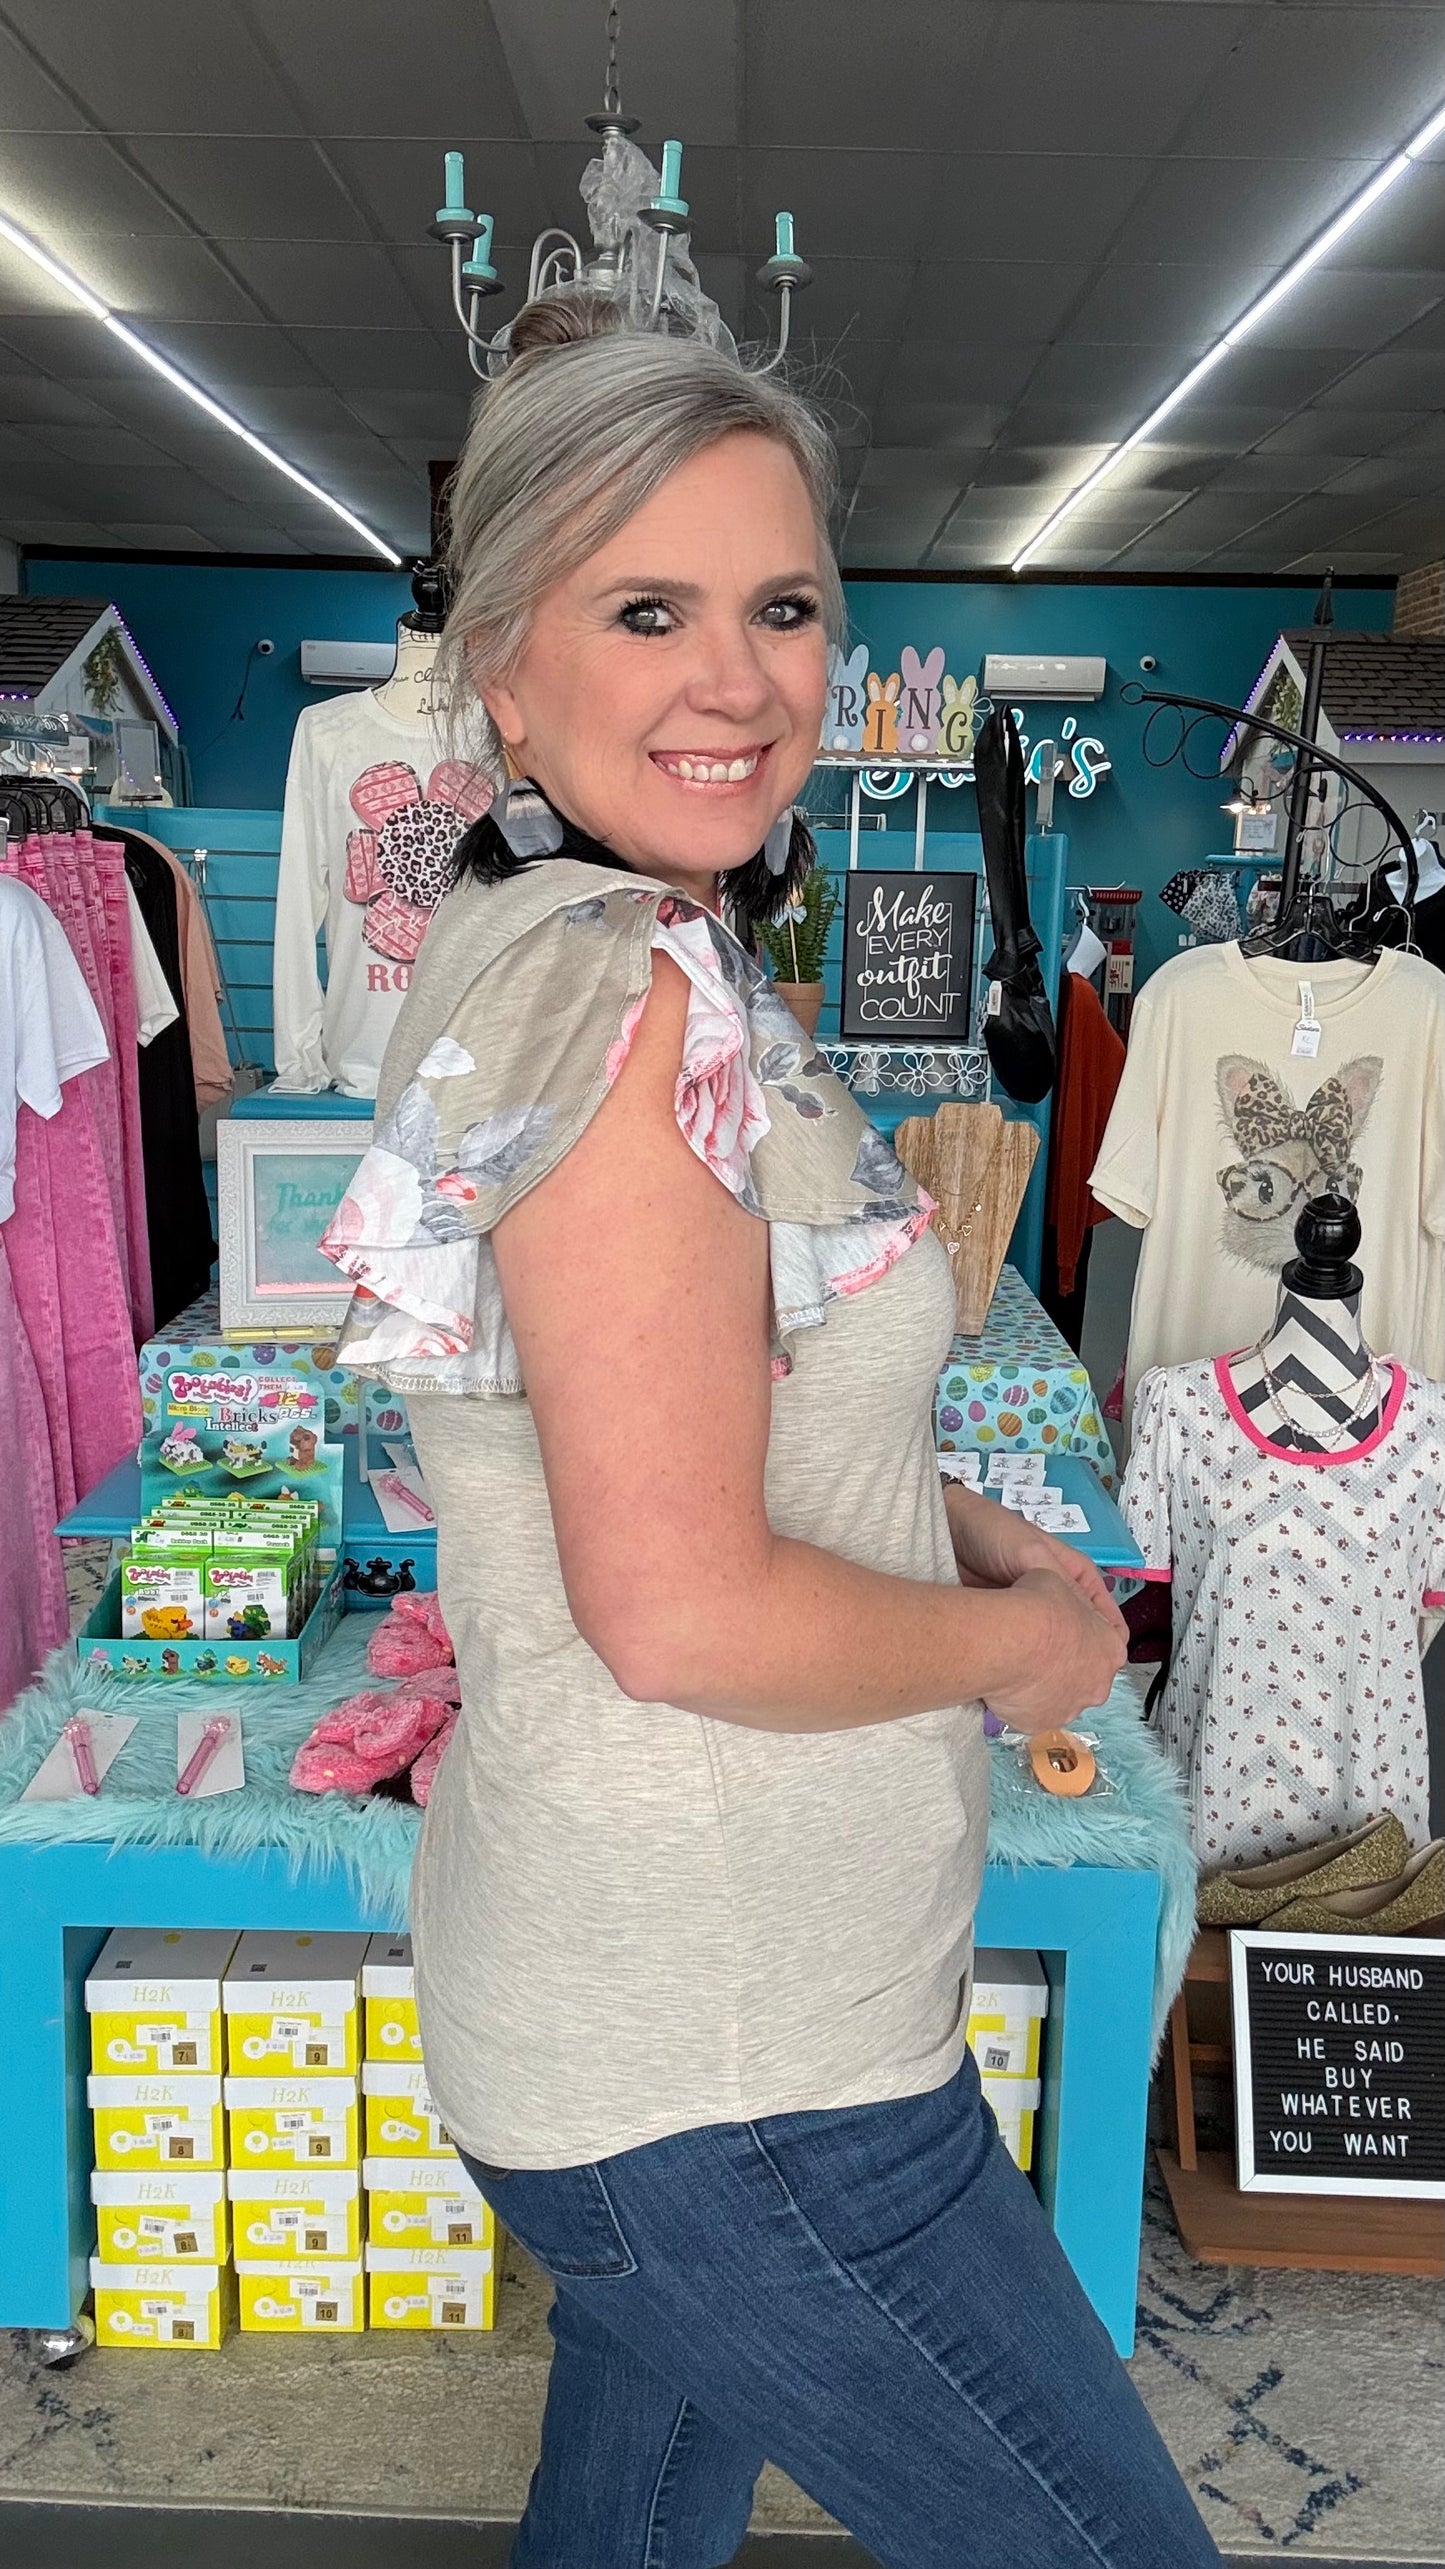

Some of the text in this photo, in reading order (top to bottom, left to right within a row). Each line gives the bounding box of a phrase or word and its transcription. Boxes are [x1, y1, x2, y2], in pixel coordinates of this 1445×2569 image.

[856, 884, 950, 937] Make
[868, 927, 949, 955] EVERY
[856, 951, 953, 1000] outfit
[860, 992, 961, 1021] COUNT
[277, 1391, 300, 1406] 12
[205, 1416, 259, 1432] Intellect
[220, 1407, 279, 1425] Bricks
[1261, 1961, 1424, 1990] YOUR HUSBAND
[133, 1985, 174, 2001] H2K
[271, 1990, 312, 2007] H2K
[1296, 2037, 1405, 2063] HE SAID
[990, 2055, 1004, 2068] 10
[1324, 2066, 1373, 2090] BUY
[135, 2084, 176, 2101] H2K
[271, 2087, 312, 2103] H2K
[1280, 2092, 1412, 2120] WHATEVER
[1269, 2130, 1409, 2157] YOU WANT
[273, 2179, 314, 2195] H2K
[409, 2170, 449, 2187] H2K
[138, 2183, 178, 2200] H2K
[136, 2268, 176, 2285] H2K
[320, 2308, 333, 2319] 10
